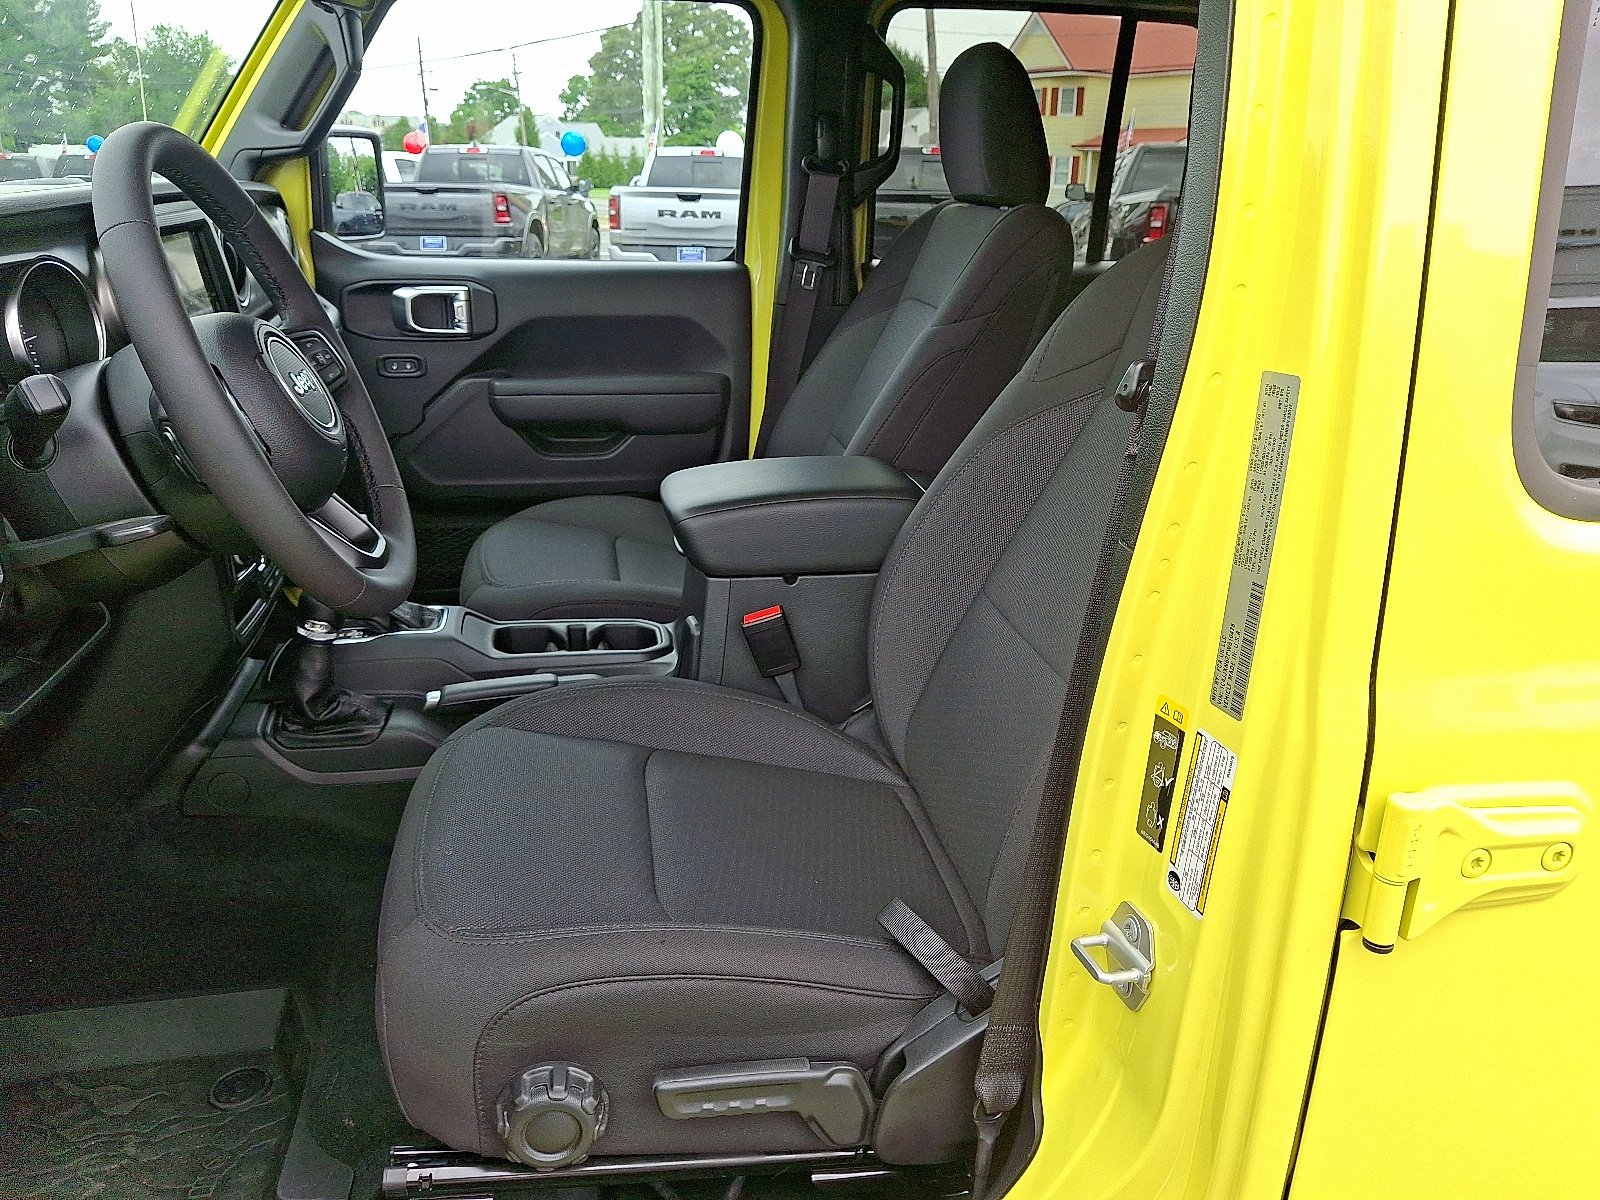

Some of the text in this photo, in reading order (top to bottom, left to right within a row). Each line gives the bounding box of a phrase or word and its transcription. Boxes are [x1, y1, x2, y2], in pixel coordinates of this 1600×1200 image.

[400, 203, 457, 211] RAM
[657, 209, 721, 219] RAM
[289, 369, 316, 395] Jeep
[1223, 682, 1231, 708] VEHICLE
[1233, 629, 1241, 648] U.S.A.
